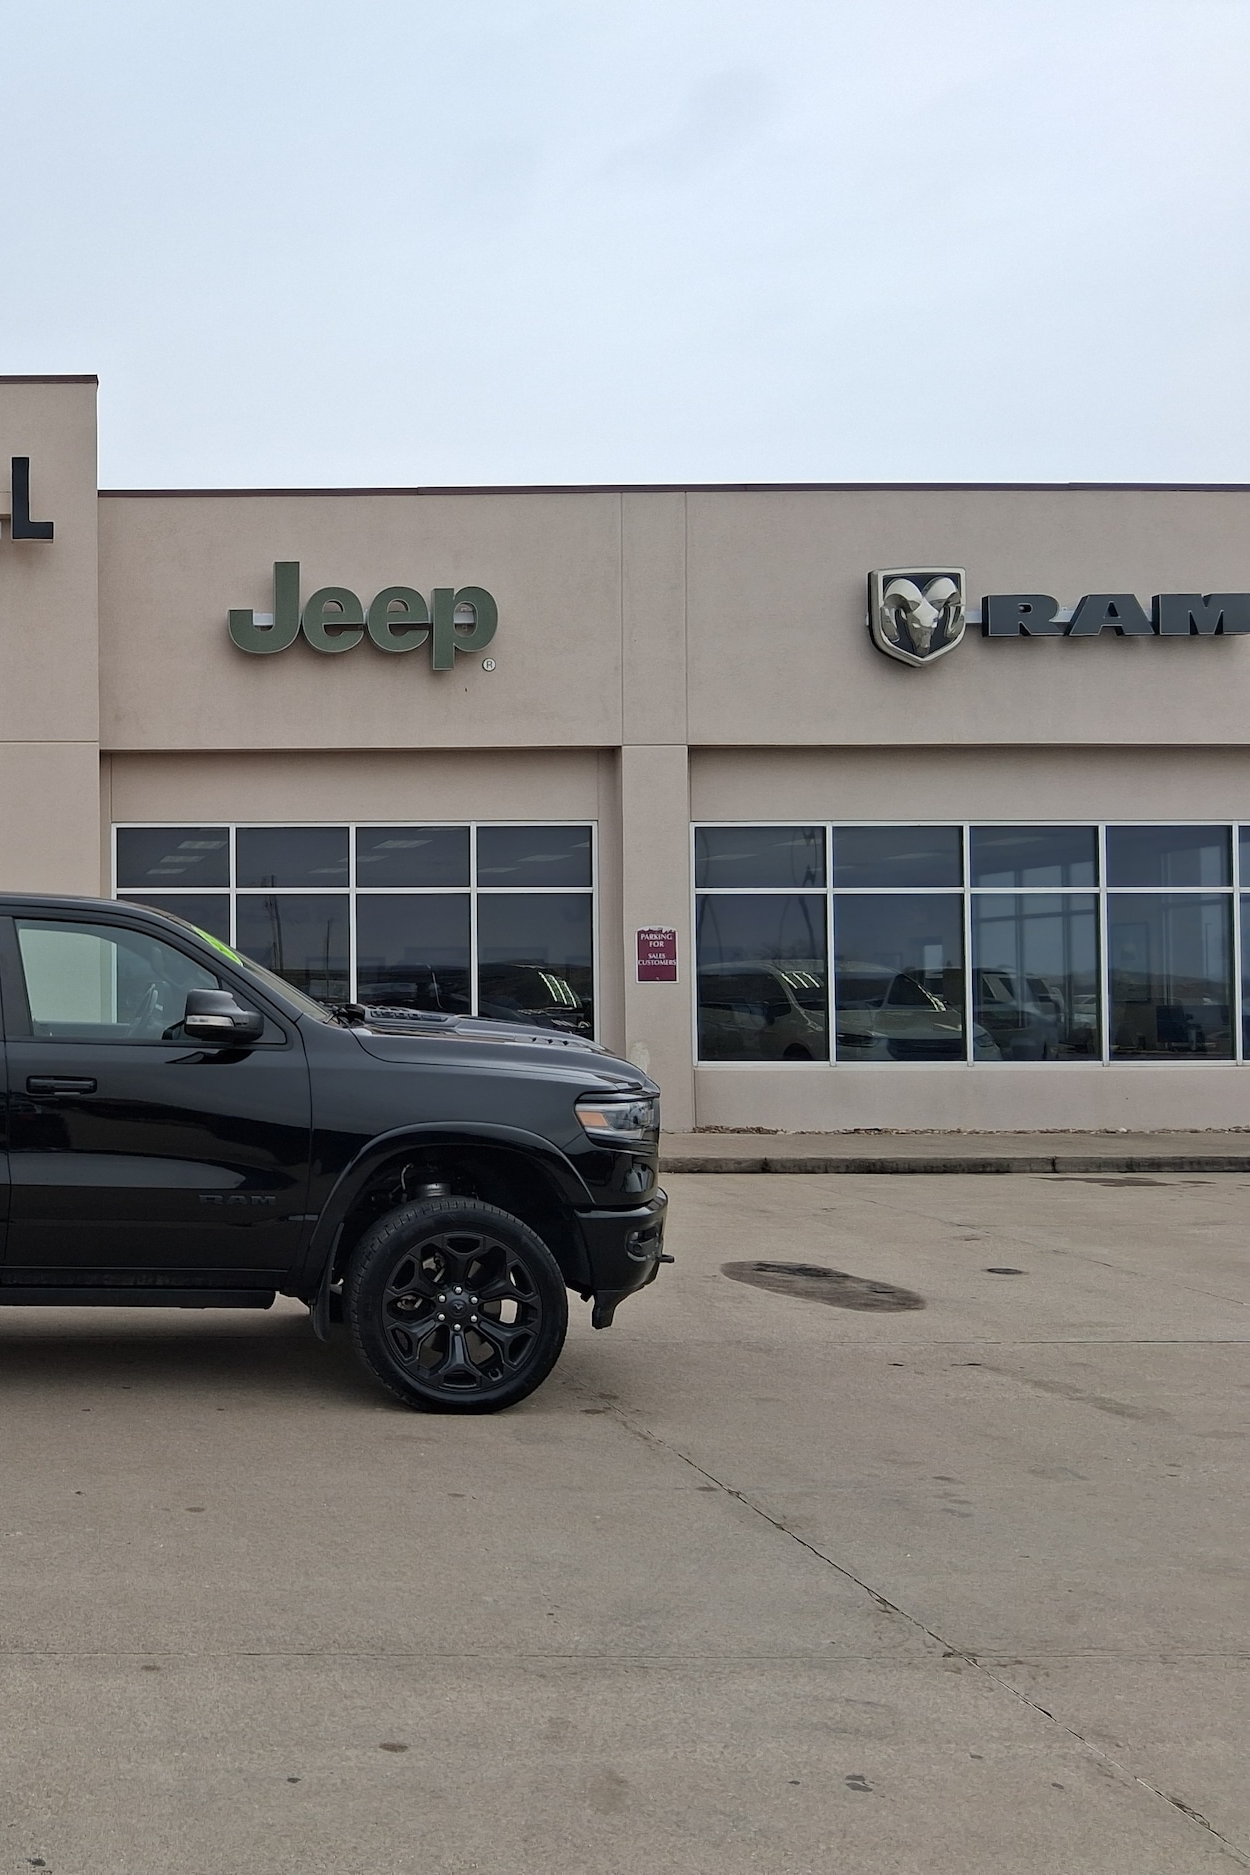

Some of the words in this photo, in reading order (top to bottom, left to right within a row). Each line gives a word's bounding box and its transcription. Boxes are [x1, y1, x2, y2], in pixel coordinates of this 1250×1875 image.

[227, 559, 499, 671] Jeep
[981, 592, 1250, 637] RAM
[199, 1194, 276, 1205] RAM
